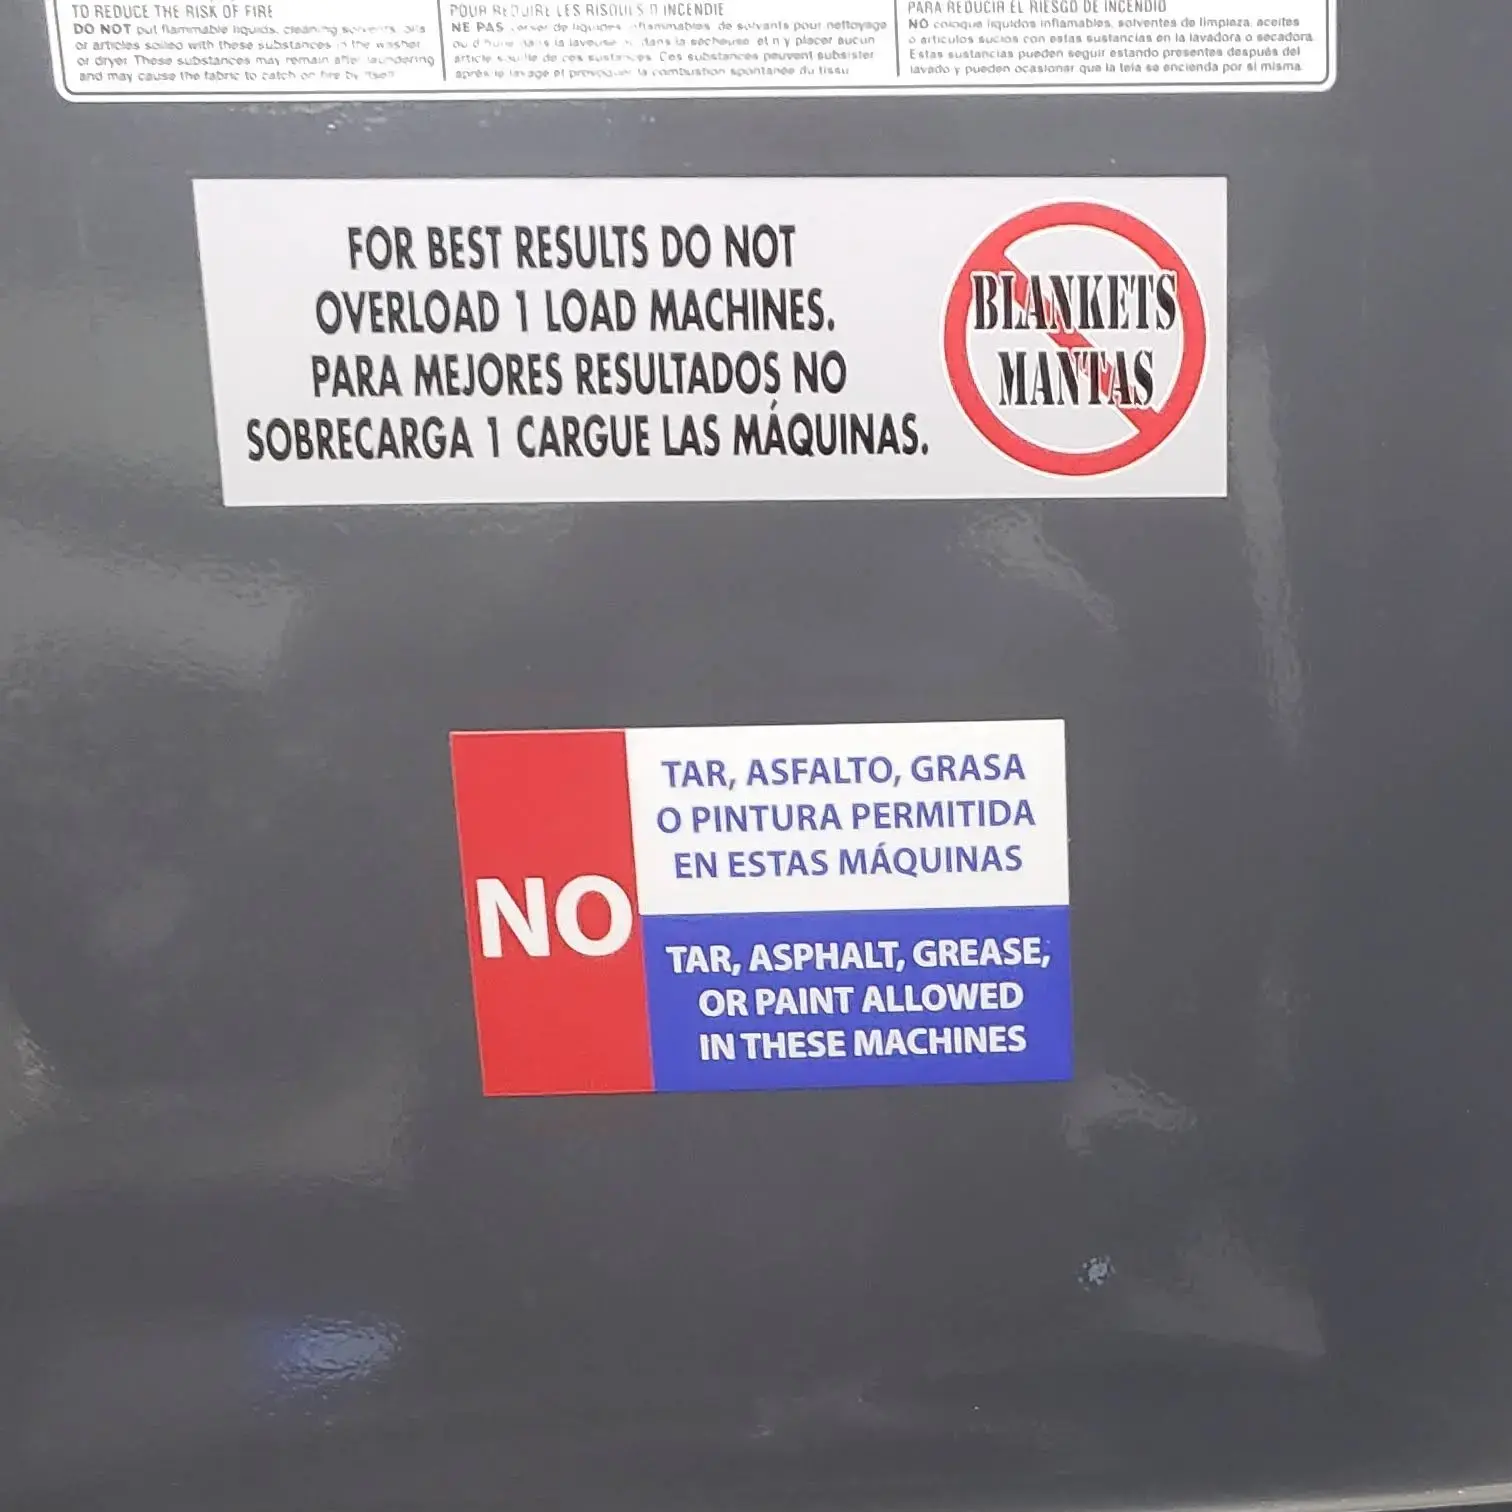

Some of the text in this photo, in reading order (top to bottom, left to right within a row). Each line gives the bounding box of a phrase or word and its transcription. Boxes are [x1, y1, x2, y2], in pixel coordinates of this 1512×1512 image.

[72, 5, 272, 18] TO REDUCE THE RISK OF FIRE
[450, 4, 487, 17] POUR
[557, 4, 580, 17] LES
[908, 0, 1167, 13] PARA REDUCIR EL RIESGO DE INCENDIO
[908, 18, 929, 29] NO
[1118, 17, 1176, 28] solventes
[1181, 17, 1195, 27] de
[1257, 17, 1299, 27] aceites
[73, 24, 95, 34] DO
[100, 24, 132, 34] NOT
[136, 24, 157, 36] put
[162, 24, 228, 35] flammable
[451, 22, 469, 33] NE
[476, 22, 504, 33] PAS
[1023, 35, 1046, 43] con
[1050, 34, 1082, 43] estas
[1087, 33, 1153, 43] sustancias
[1156, 34, 1170, 43] en
[1175, 33, 1185, 42] la
[1190, 32, 1241, 42] lavadora
[1245, 33, 1253, 42] o
[75, 42, 87, 50] or
[188, 40, 214, 50] with
[219, 40, 253, 50] these
[77, 57, 89, 66] or
[134, 55, 172, 65] These
[177, 55, 250, 65] substances
[909, 48, 943, 59] Estas
[948, 50, 1013, 59] sustancias
[1018, 49, 1063, 60] pueden
[1068, 48, 1105, 60] seguir
[1110, 48, 1159, 58] estando
[1163, 47, 1223, 59] presentes
[1282, 46, 1300, 57] del
[79, 72, 102, 81] and
[107, 73, 132, 83] may
[180, 72, 200, 81] the
[245, 71, 256, 80] to
[911, 64, 950, 74] lavado
[965, 64, 1010, 75] pueden
[1014, 64, 1074, 74] ocasionar
[1079, 64, 1101, 76] que
[1105, 63, 1115, 72] la
[1146, 64, 1159, 72] se
[1164, 62, 1218, 72] encienda
[1223, 63, 1242, 74] por
[349, 225, 795, 269] FOR BEST RESULTS DO NOT
[317, 288, 834, 334] OVERLOAD 1 LOAD MACHINES.
[970, 271, 1177, 331] BLANKETS
[312, 351, 846, 397] PARA MEJORES RESULTADOS NO
[998, 348, 1155, 408] MANTAS
[248, 400, 928, 460] SOBRECARGA 1 CARGUE LAS MÁQUINAS.
[662, 754, 1025, 790] TAR, ASFALTO, GRASA
[656, 800, 1035, 834] O PINTURA PERMITIDA
[675, 842, 1022, 879] EN ESTAS MÁQUINAS
[478, 876, 632, 957] NO
[666, 937, 1049, 975] TAR, ASPHALT, GREASE,
[699, 982, 1023, 1016] OR PAINT ALLOWED
[700, 1025, 1026, 1060] IN THESE MACHINES
